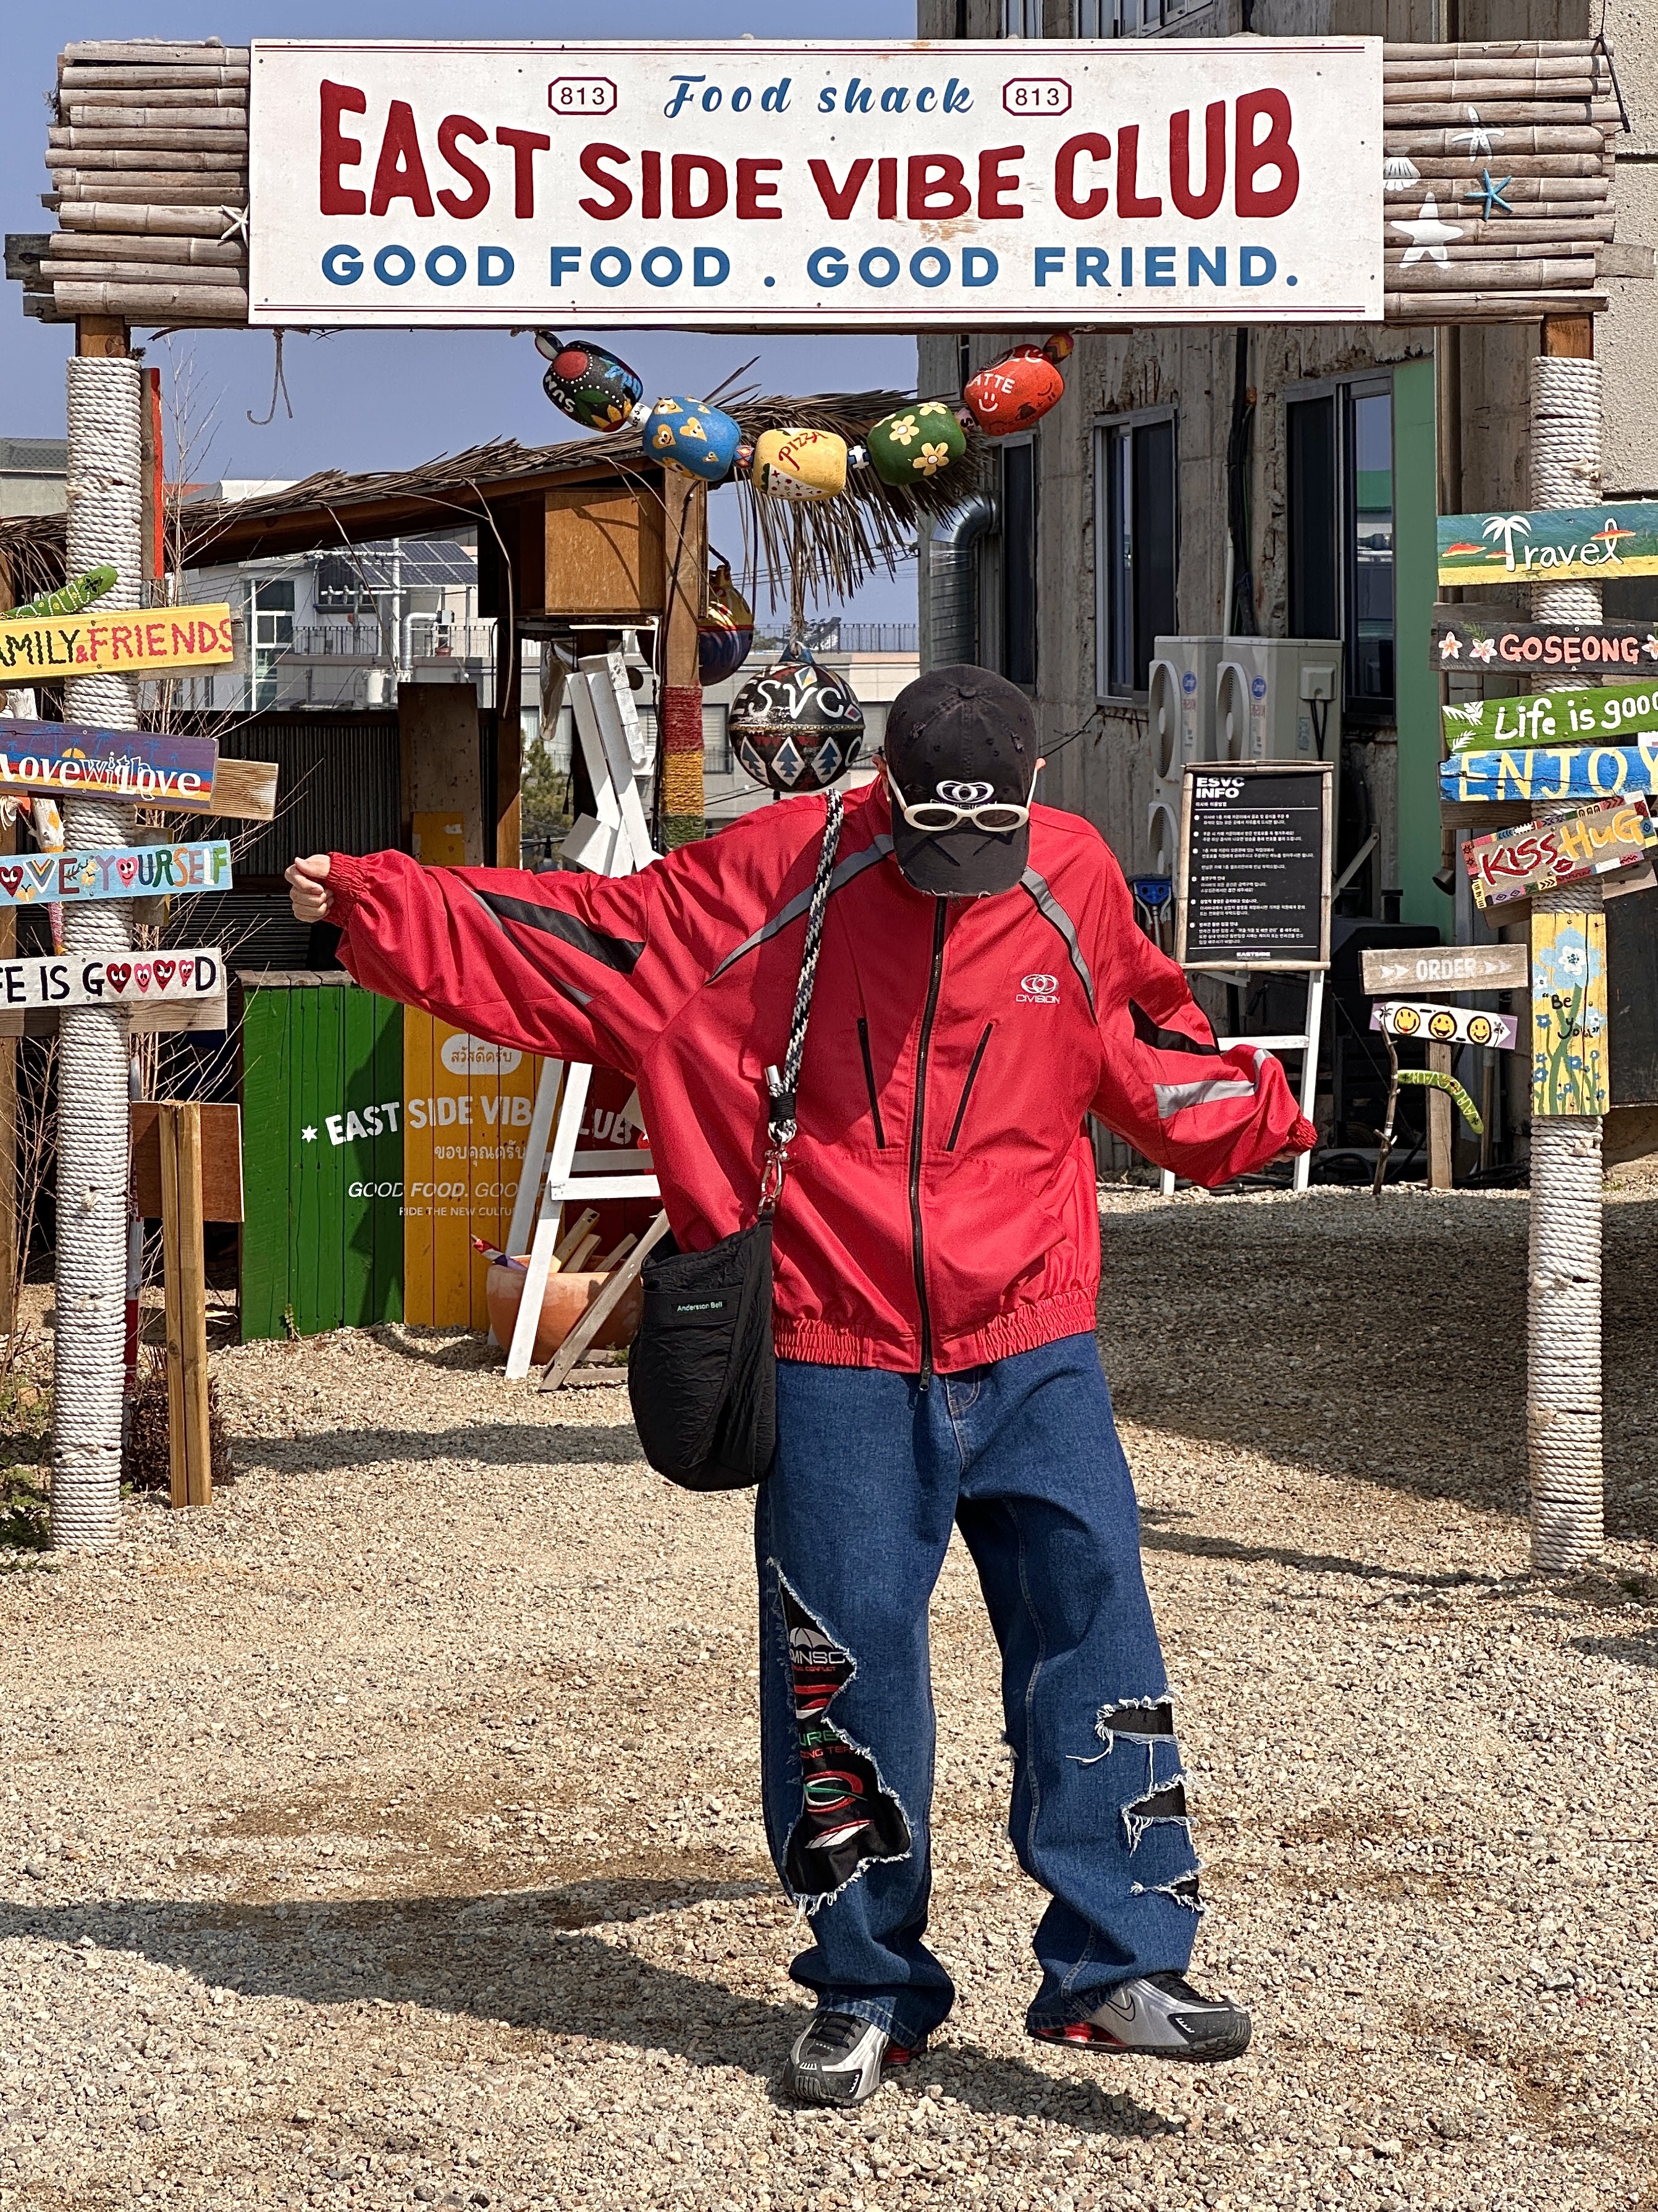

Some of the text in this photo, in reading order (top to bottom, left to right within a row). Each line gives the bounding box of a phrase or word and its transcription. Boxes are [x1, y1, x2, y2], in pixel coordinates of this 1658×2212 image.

[561, 87, 605, 105] 813
[663, 74, 974, 118] Food shack
[1015, 88, 1060, 106] 813
[319, 78, 1300, 221] EAST SIDE VIBE CLUB
[321, 244, 515, 287] GOOD
[550, 245, 731, 287] FOOD
[807, 246, 999, 288] GOOD
[1034, 246, 1298, 287] FRIEND.
[969, 373, 1016, 394] ATTE
[1481, 515, 1625, 572] Travel
[0, 629, 81, 667] MILY
[1499, 633, 1640, 665] GOSEONG
[1494, 697, 1557, 741] Life
[1567, 699, 1596, 732] is
[1196, 776, 1245, 788] ESVC
[1458, 746, 1658, 802] ENJOY
[1195, 787, 1240, 799] INFO
[39, 965, 71, 1001] IS
[1415, 956, 1477, 981] ORDER
[325, 1101, 400, 1147] EAST
[408, 1095, 474, 1129] SIDE
[480, 1095, 532, 1126] VIB
[348, 1181, 403, 1198] GOOD
[410, 1181, 468, 1198] FOOD.
[474, 1181, 519, 1198] GOO
[398, 1207, 516, 1217] RIDE THE NEW CULTU
